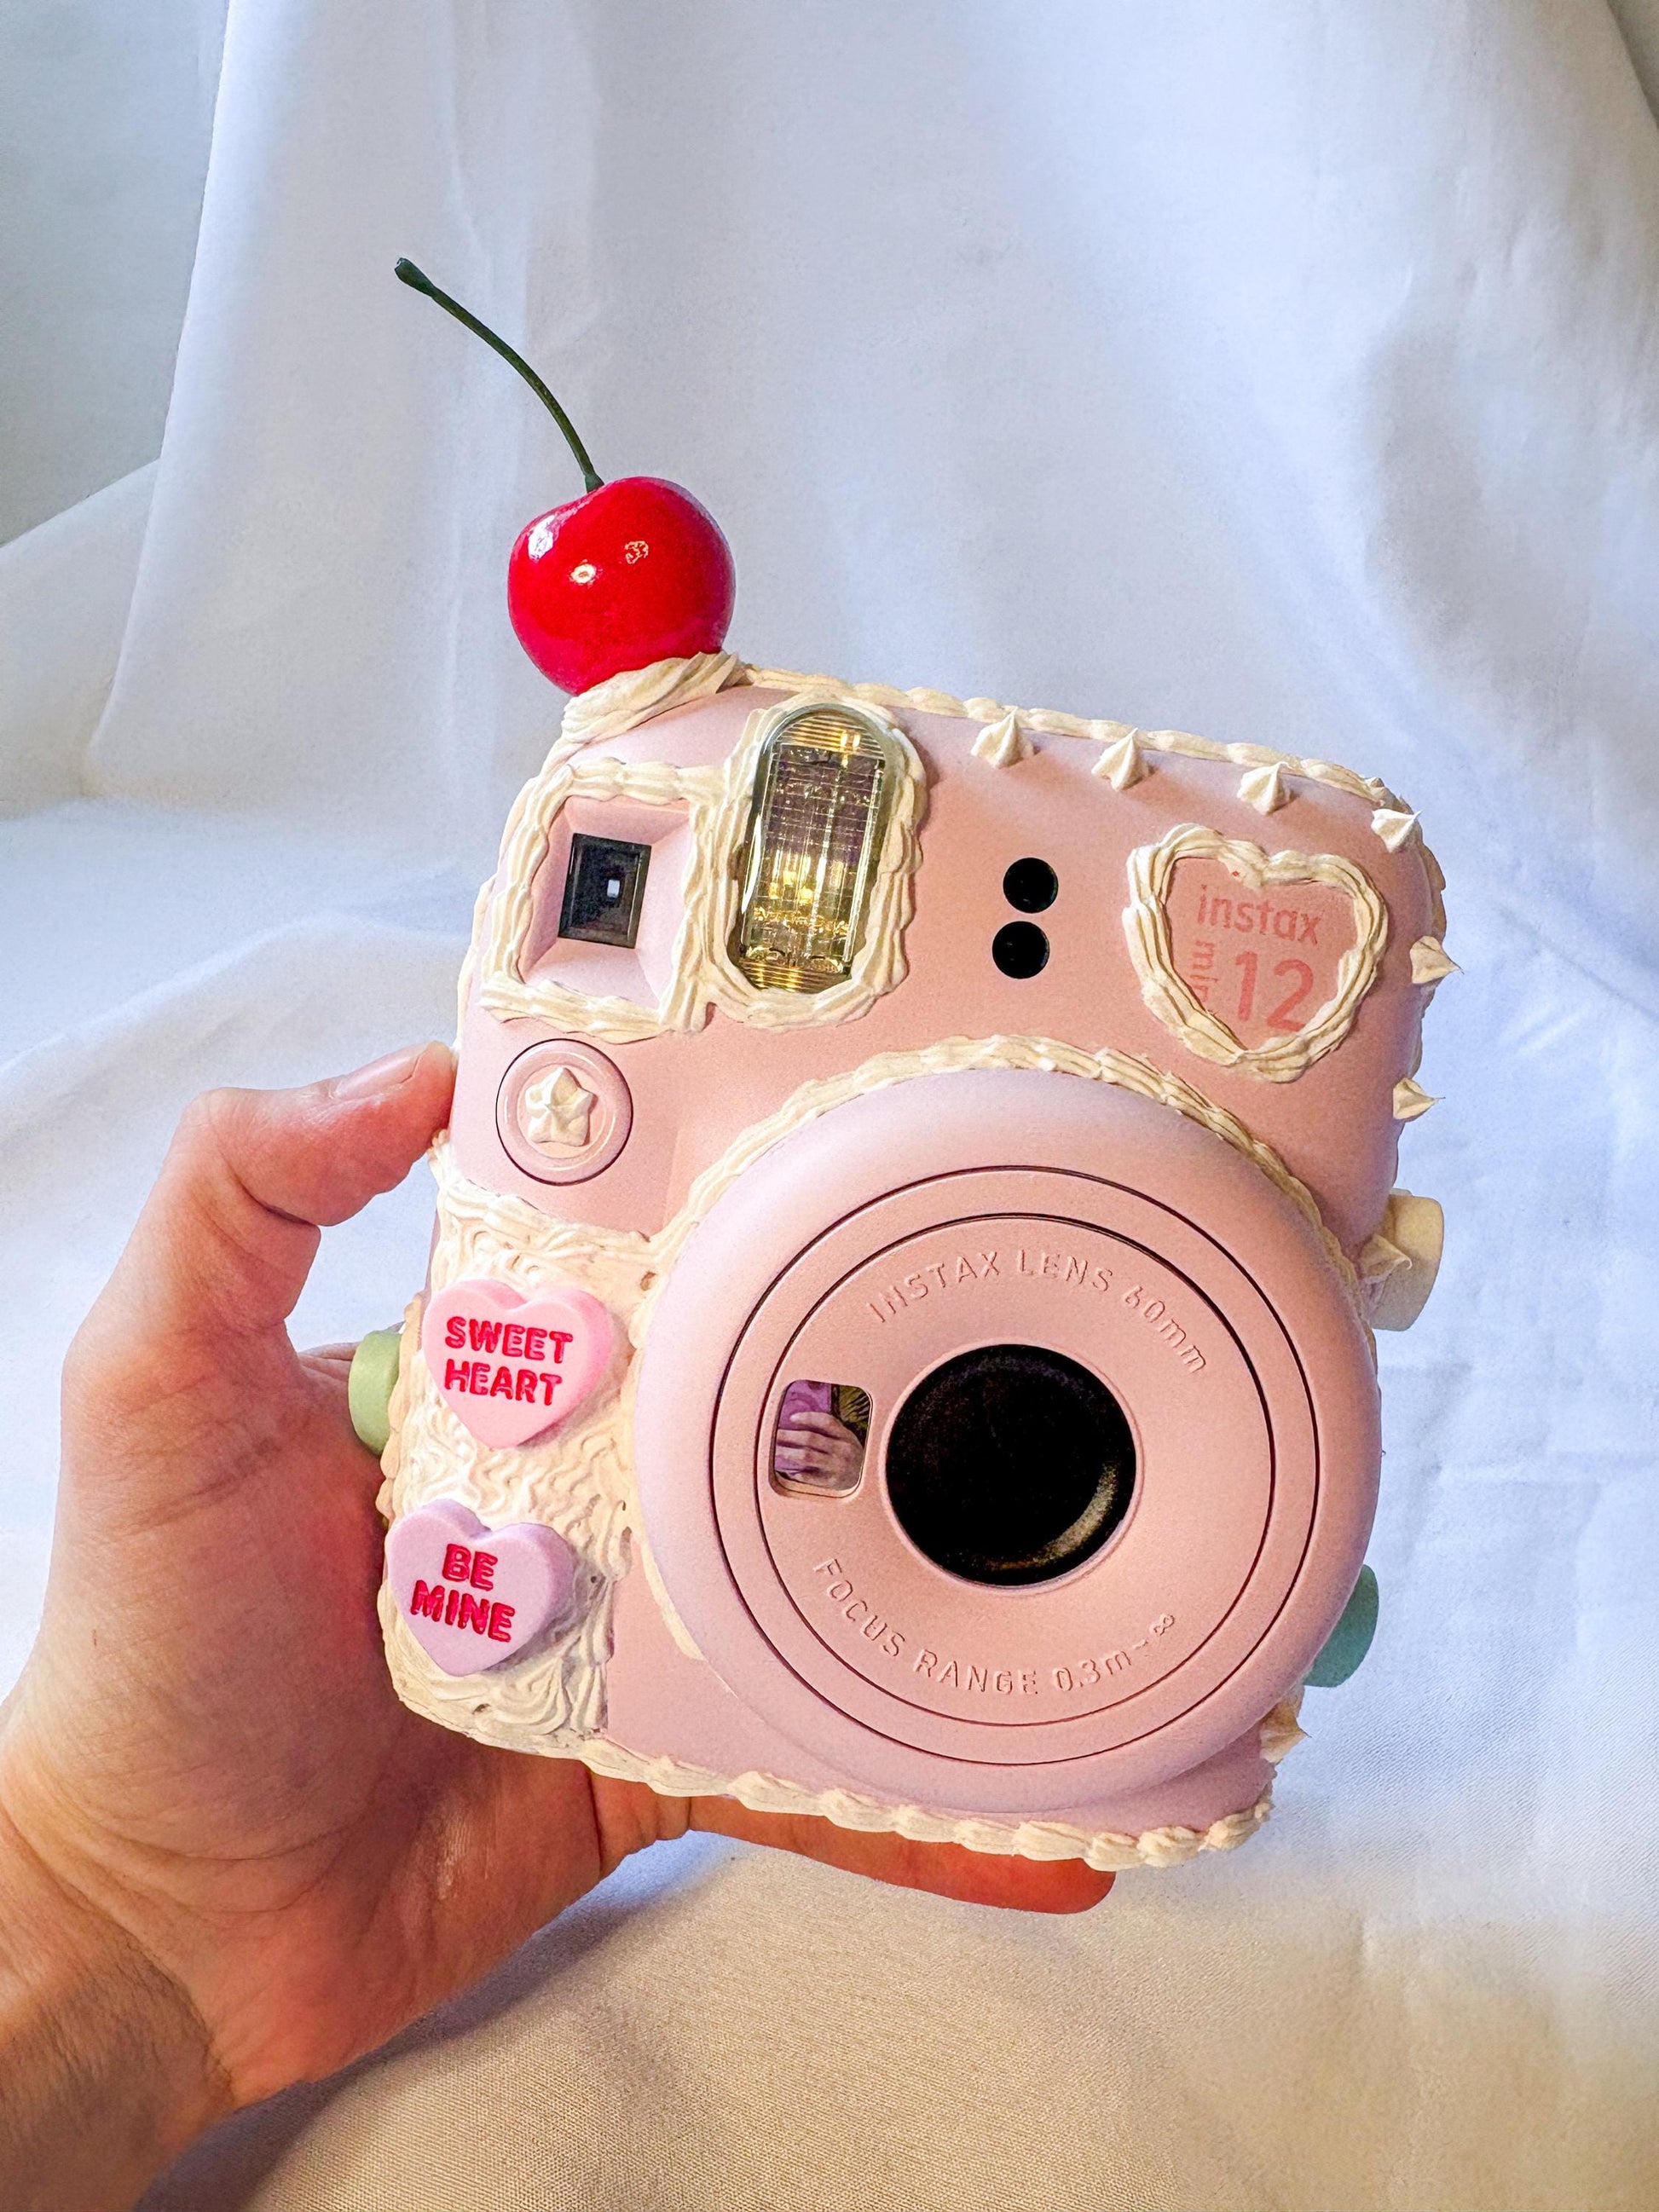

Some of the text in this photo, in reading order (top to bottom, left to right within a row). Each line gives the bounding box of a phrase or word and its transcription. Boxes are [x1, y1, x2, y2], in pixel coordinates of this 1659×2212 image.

[1197, 885, 1321, 944] instax
[1234, 950, 1312, 1031] 12
[445, 1316, 573, 1364] SWEET
[865, 1250, 1207, 1374] INSTAX LENS 60mm
[444, 1359, 563, 1406] HEART
[442, 1543, 498, 1591] BE
[410, 1580, 516, 1643] MINE
[812, 1558, 906, 1657] FOCUS
[913, 1649, 1038, 1695] RANGE
